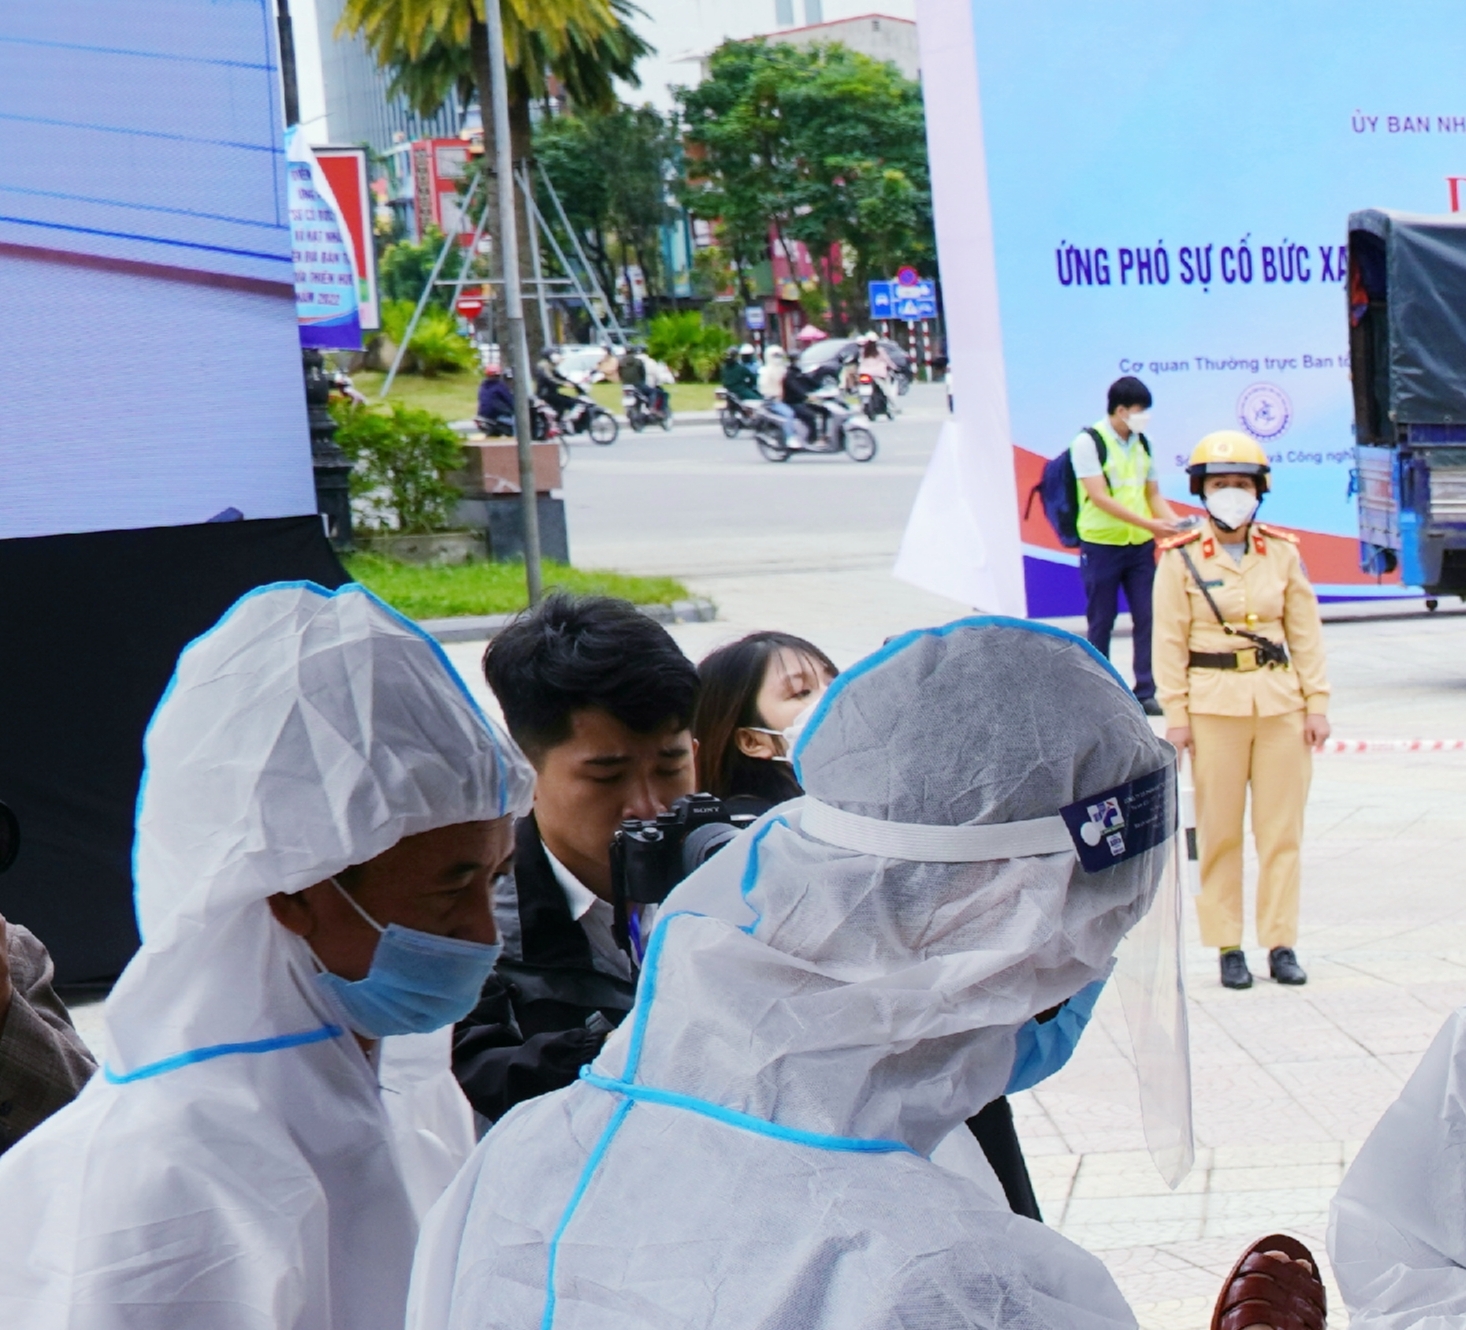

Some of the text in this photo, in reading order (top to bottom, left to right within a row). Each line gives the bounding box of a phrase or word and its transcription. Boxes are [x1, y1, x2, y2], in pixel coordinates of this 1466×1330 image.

[1352, 110, 1379, 134] ỦY
[1387, 116, 1431, 134] BAN
[1056, 239, 1110, 286] ỨNG
[1118, 238, 1169, 285] PHÓ
[1179, 243, 1212, 293] SỰ
[1220, 232, 1252, 283] CỐ
[1262, 238, 1310, 283] BỨC
[1119, 358, 1144, 373] Cơ
[1149, 359, 1189, 375] quan
[1195, 356, 1259, 373] Thường
[1264, 356, 1297, 372] trực
[1303, 354, 1334, 368] Ban
[1287, 450, 1322, 465] Công
